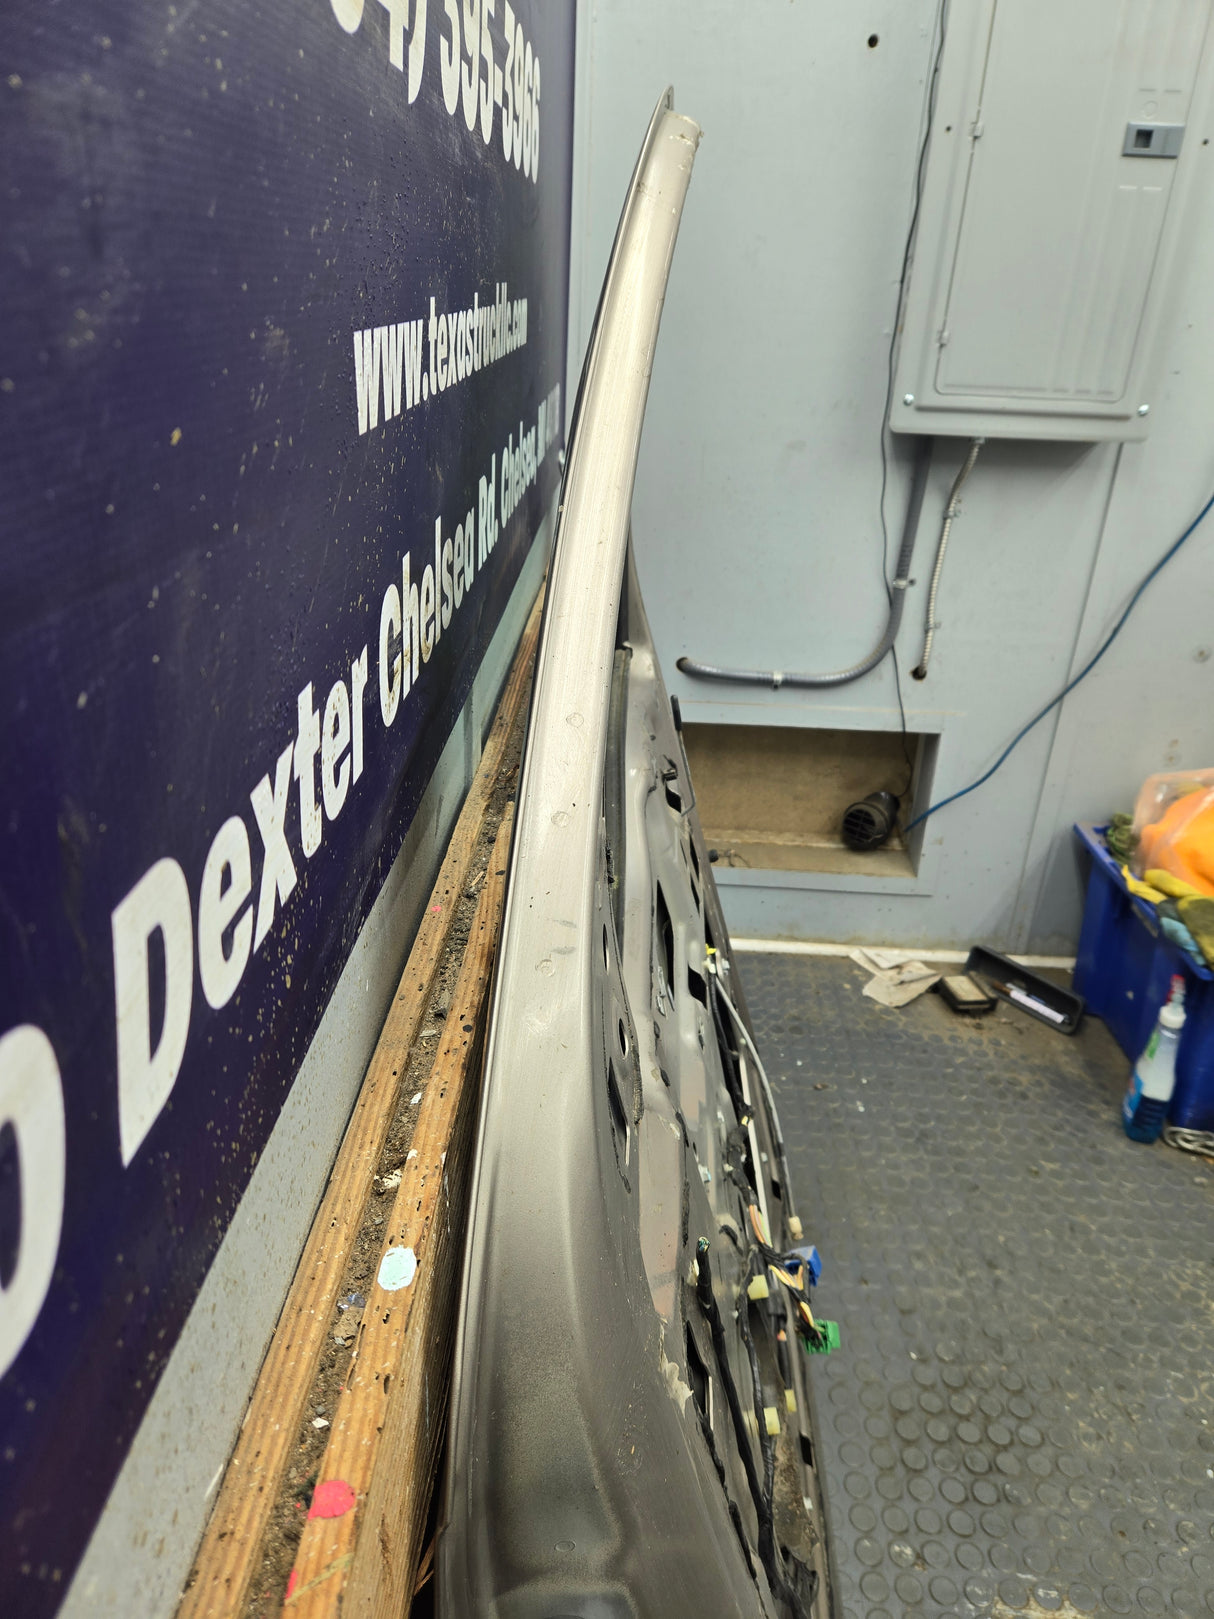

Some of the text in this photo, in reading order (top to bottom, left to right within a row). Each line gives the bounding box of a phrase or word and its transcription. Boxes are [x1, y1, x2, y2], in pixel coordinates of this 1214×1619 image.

[111, 645, 368, 1169] Dexter
[379, 507, 475, 727] Chelsea
[478, 453, 498, 571] Rd.
